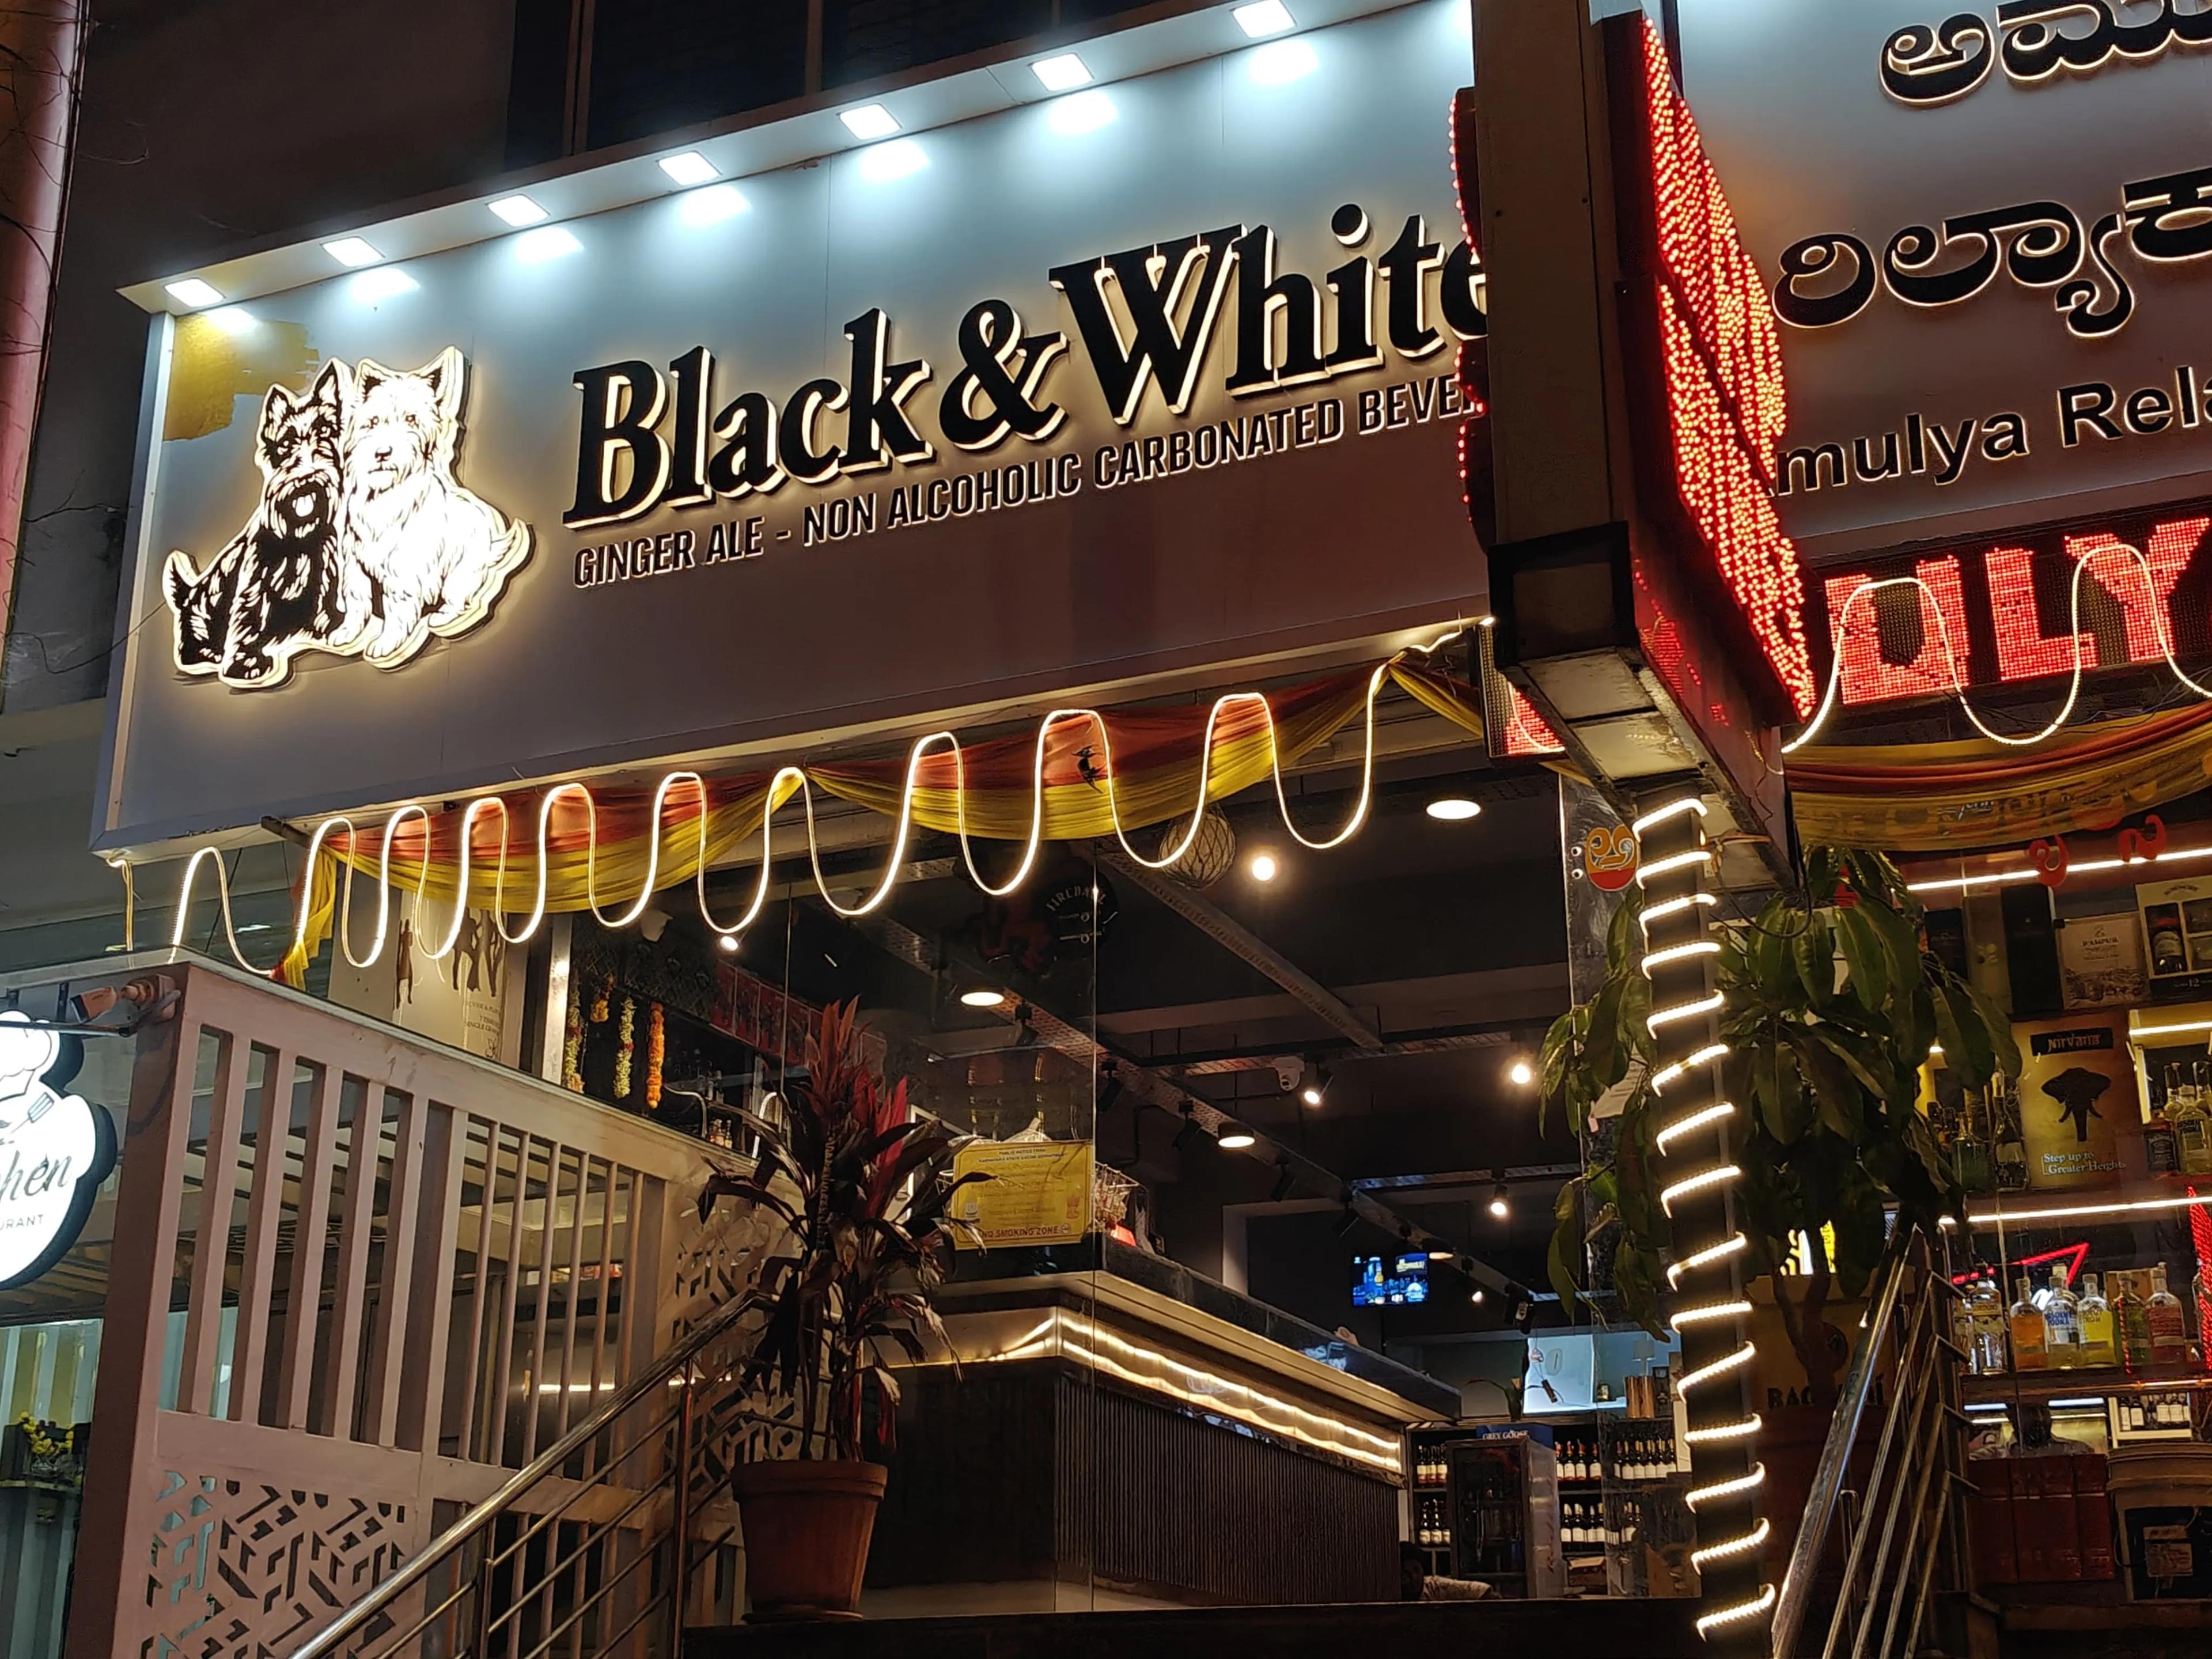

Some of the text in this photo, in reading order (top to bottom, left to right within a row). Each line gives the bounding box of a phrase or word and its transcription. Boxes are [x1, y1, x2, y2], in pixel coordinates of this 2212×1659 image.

[1767, 366, 2212, 497] mulya Rel
[574, 529, 695, 588] GINGER
[705, 517, 765, 566] ALE
[804, 493, 877, 547] NON
[887, 453, 1082, 529] ALCOHOLIC
[1093, 398, 1344, 490] CARBONATED
[2043, 1152, 2095, 1163] Step up to
[2048, 1160, 2127, 1175] Greater Heights
[982, 1225, 1059, 1238] NO SMOKING ZONE
[1502, 1430, 1529, 1439] GOOSE
